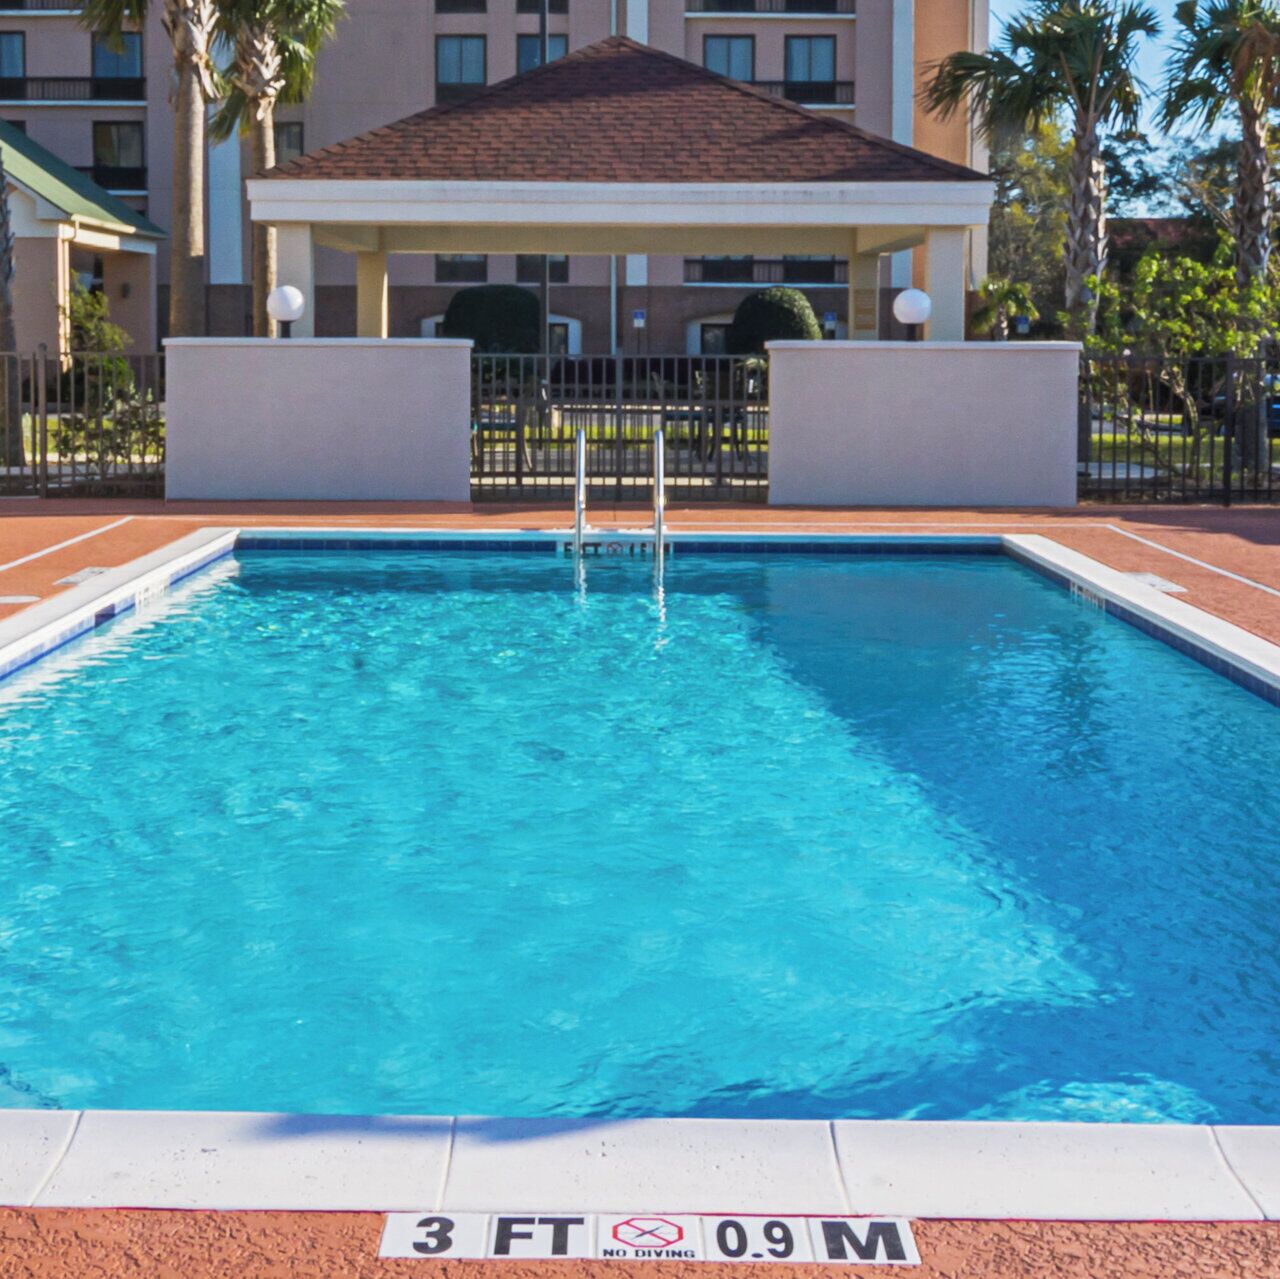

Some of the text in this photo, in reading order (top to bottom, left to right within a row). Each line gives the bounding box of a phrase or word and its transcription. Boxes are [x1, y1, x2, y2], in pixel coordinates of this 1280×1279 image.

[413, 1216, 908, 1260] 3 FT 0.9 M
[603, 1249, 695, 1259] NO DIVING
